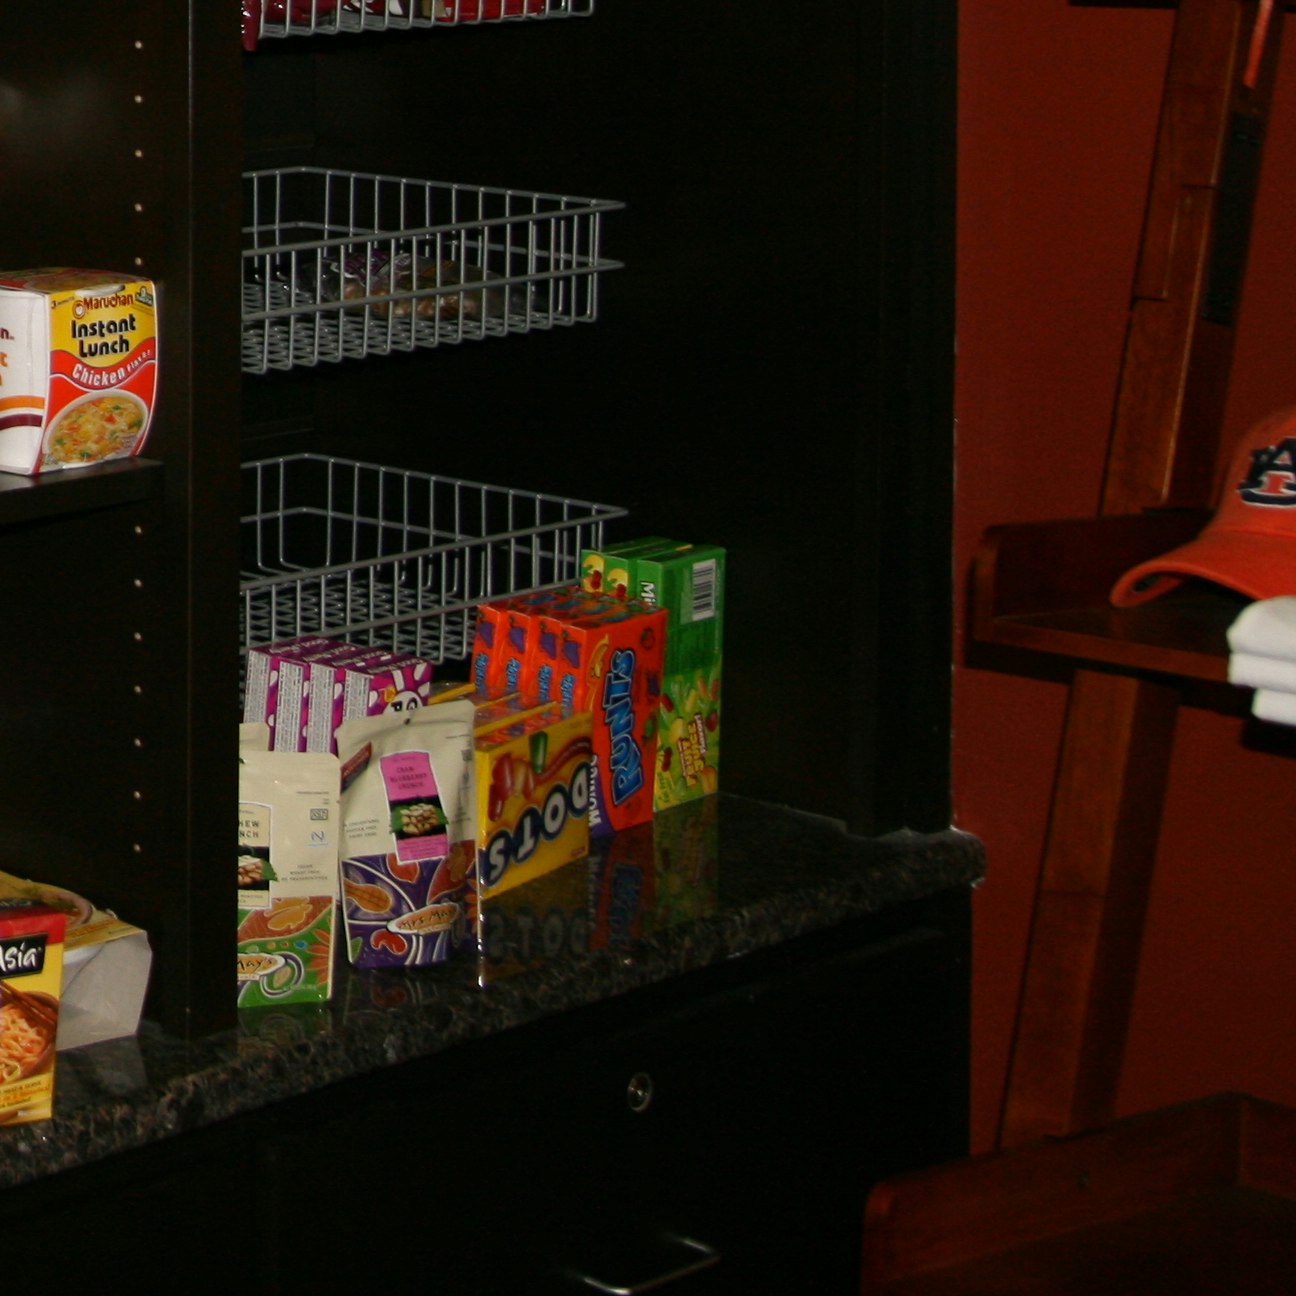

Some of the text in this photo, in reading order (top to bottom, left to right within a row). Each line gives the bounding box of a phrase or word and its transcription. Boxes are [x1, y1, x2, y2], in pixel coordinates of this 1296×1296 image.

[83, 293, 135, 311] Maruchan
[71, 313, 137, 339] Instant
[78, 334, 131, 359] Lunch
[72, 363, 127, 386] Chicken
[602, 648, 644, 806] RUNTS
